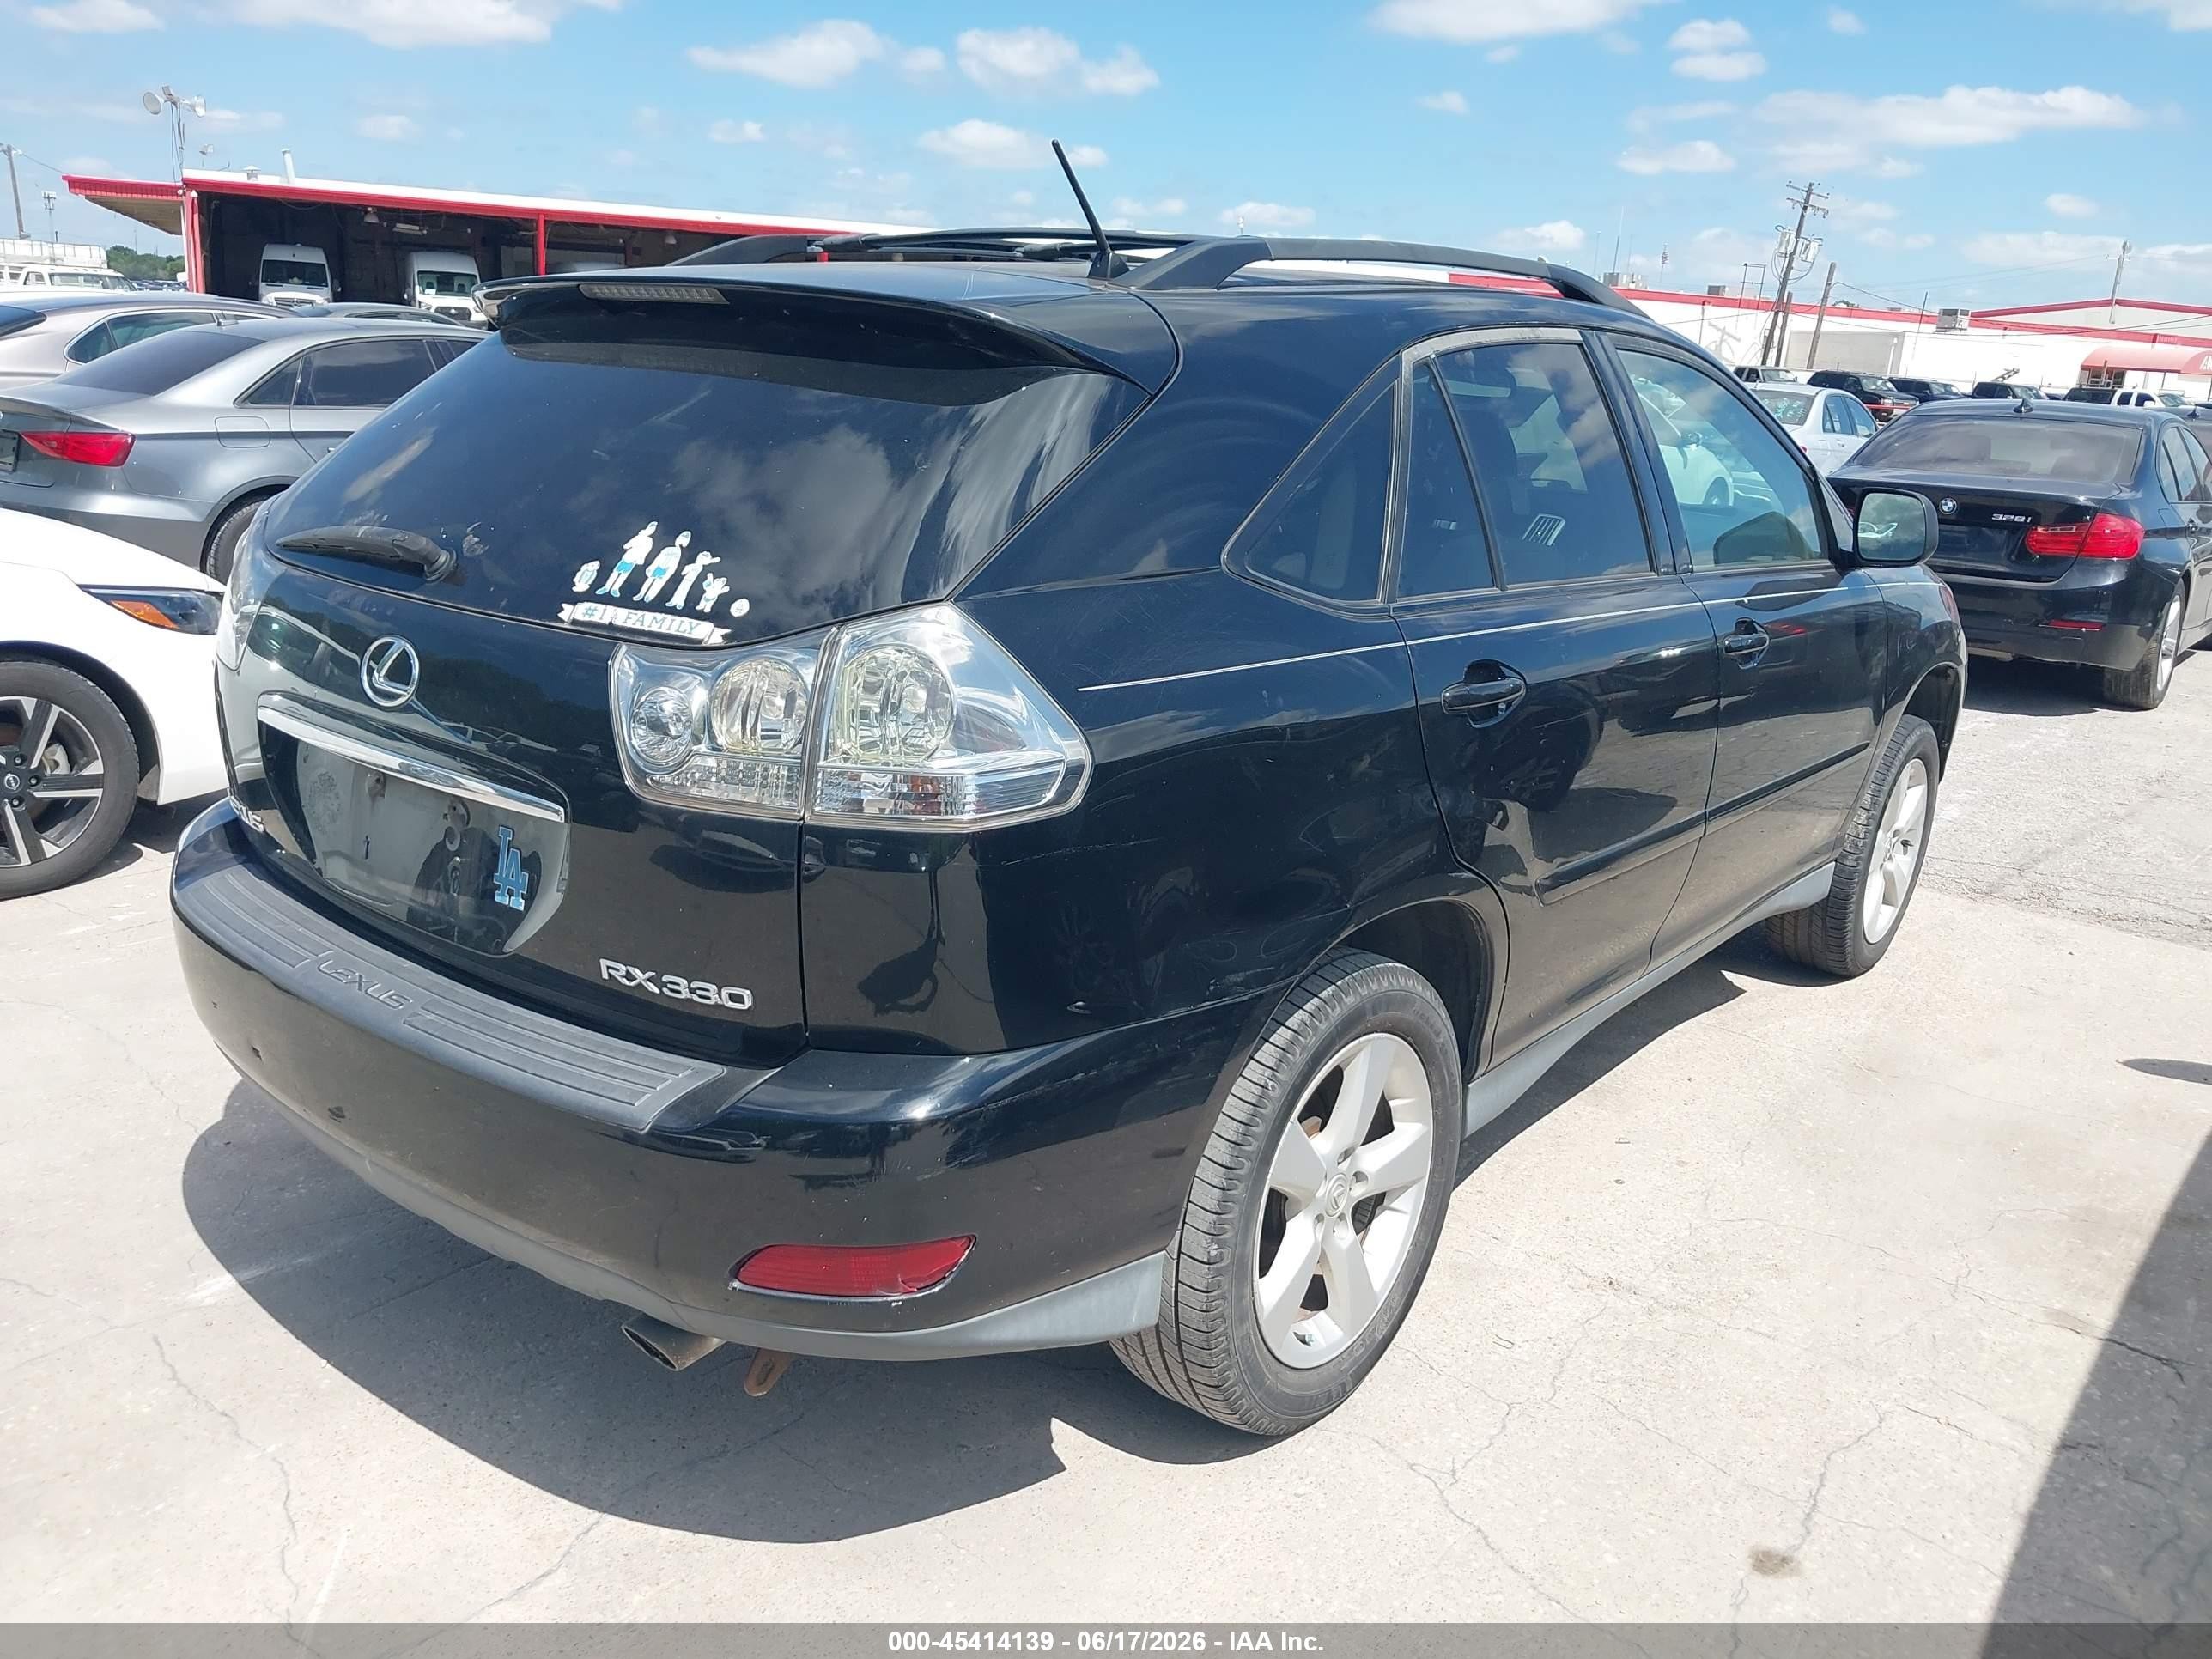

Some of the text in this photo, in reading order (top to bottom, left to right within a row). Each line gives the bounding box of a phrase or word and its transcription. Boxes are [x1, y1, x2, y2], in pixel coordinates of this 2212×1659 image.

[621, 611, 702, 635] FAMILY
[493, 825, 529, 912] LA
[317, 959, 413, 1010] LEXUS
